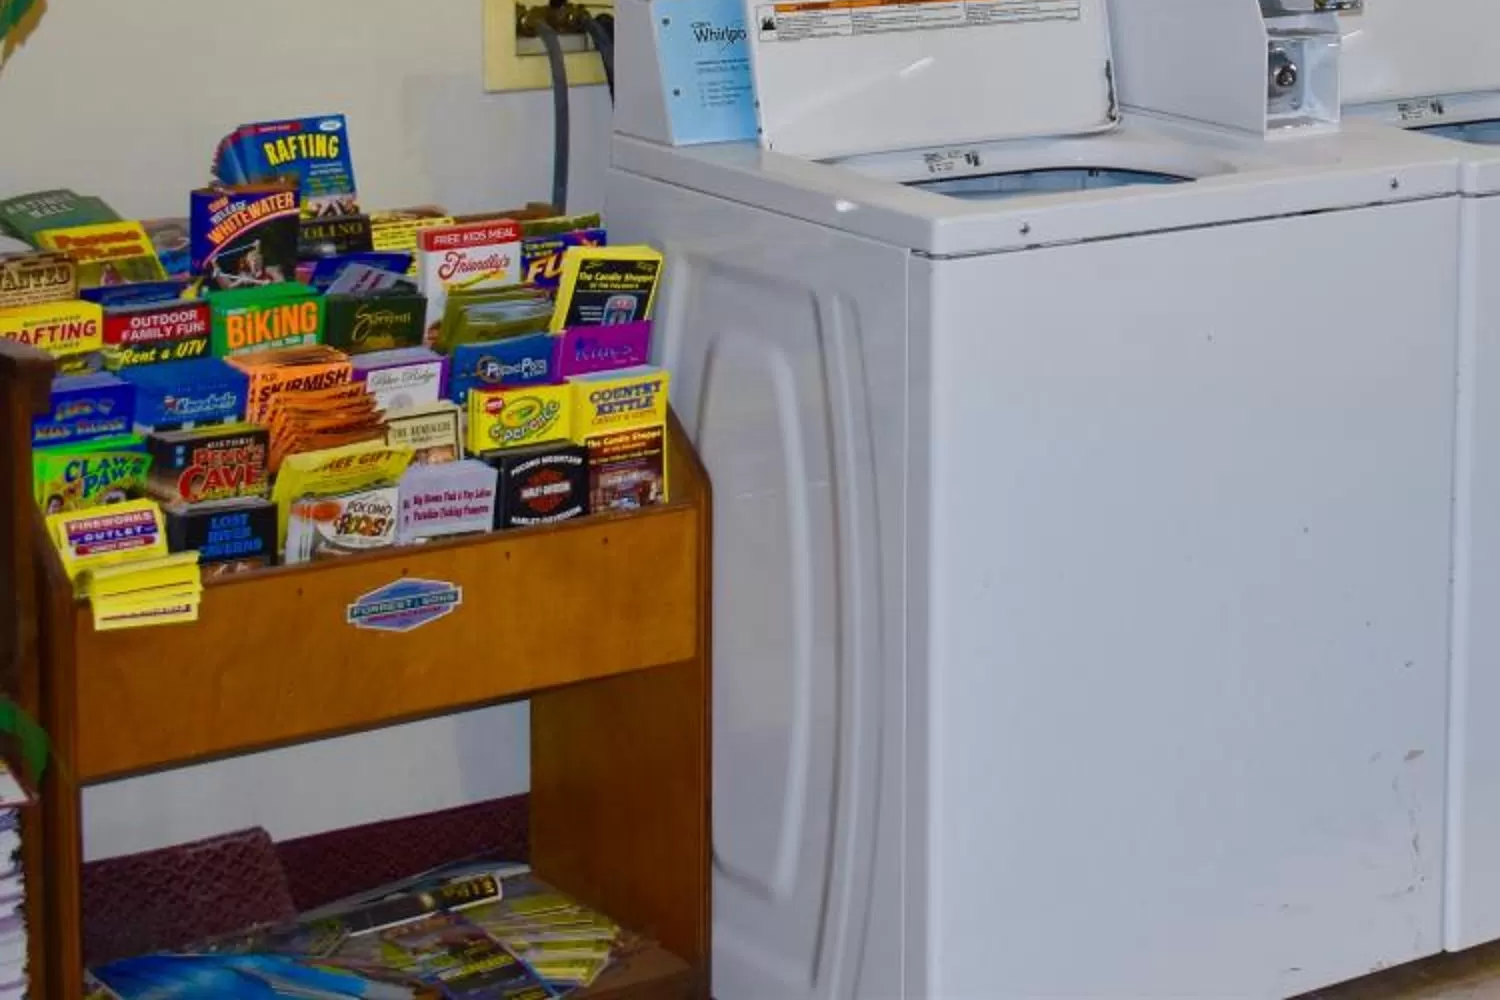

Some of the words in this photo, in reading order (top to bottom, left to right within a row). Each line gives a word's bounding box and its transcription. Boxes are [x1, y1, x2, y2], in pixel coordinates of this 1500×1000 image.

[263, 133, 339, 166] RAFTING
[433, 234, 461, 246] FREE
[463, 229, 487, 242] KIDS
[487, 227, 517, 240] MEAL
[438, 251, 511, 281] Friendly's
[129, 309, 198, 328] OUTDOOR
[120, 324, 174, 343] FAMILY
[120, 349, 157, 365] Rent
[177, 339, 207, 358] UTV
[177, 463, 264, 502] CAVE
[347, 500, 393, 516] POCONO
[69, 511, 153, 531] FIREWORKS
[210, 513, 249, 530] LOST
[84, 525, 143, 542] OUTLET
